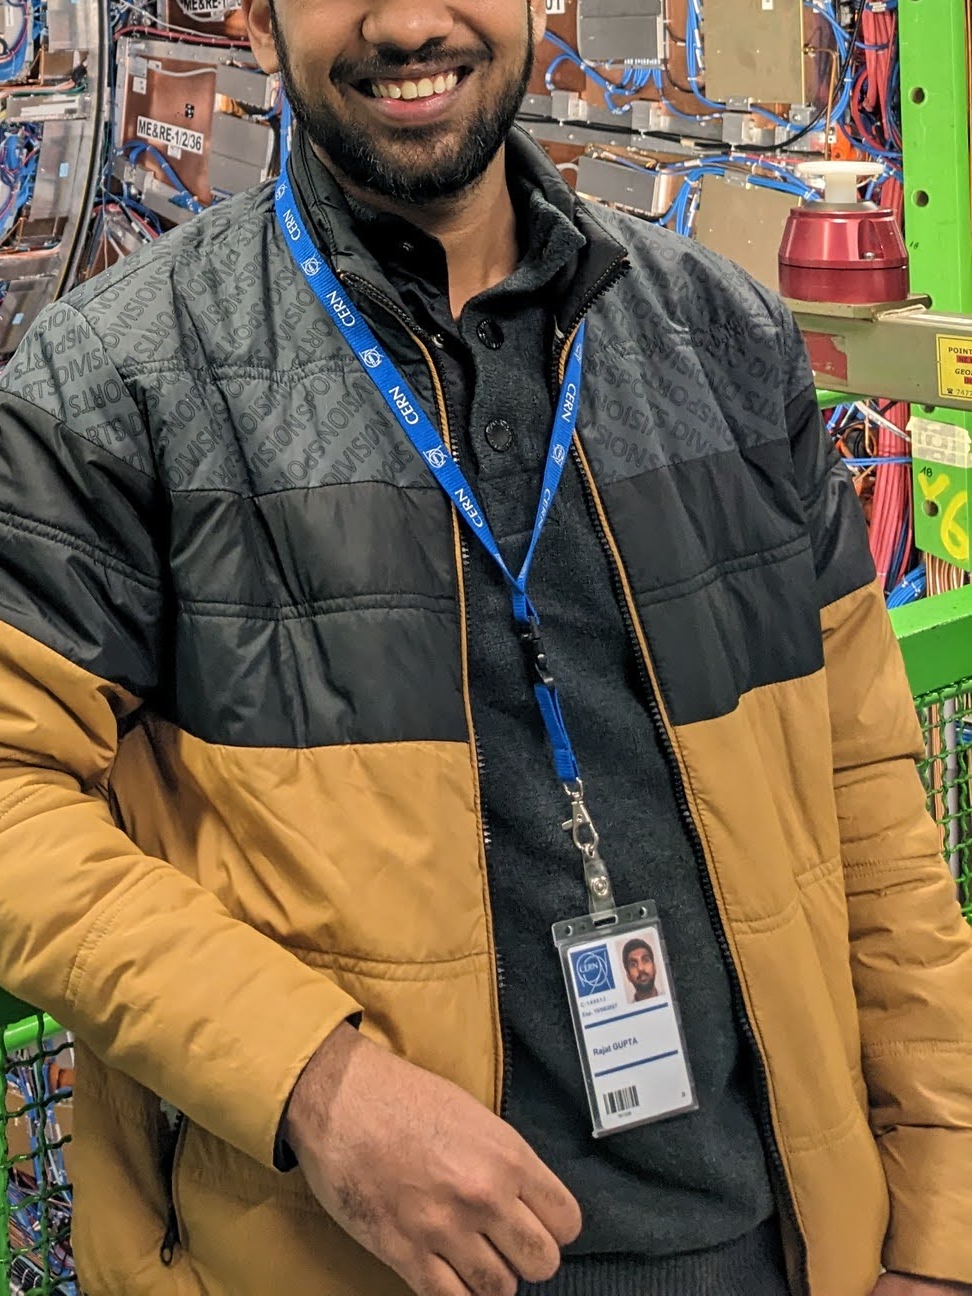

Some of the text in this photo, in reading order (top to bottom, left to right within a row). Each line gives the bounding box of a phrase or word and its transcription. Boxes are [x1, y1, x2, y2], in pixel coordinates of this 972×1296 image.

[138, 119, 202, 152] ME&RE-1/2/36
[282, 209, 301, 241] CERN
[326, 291, 356, 327] CERN
[389, 386, 419, 425] CERN
[561, 383, 577, 422] CERN
[454, 488, 484, 528] CERN
[593, 1037, 638, 1057] Rajat GUPTA
